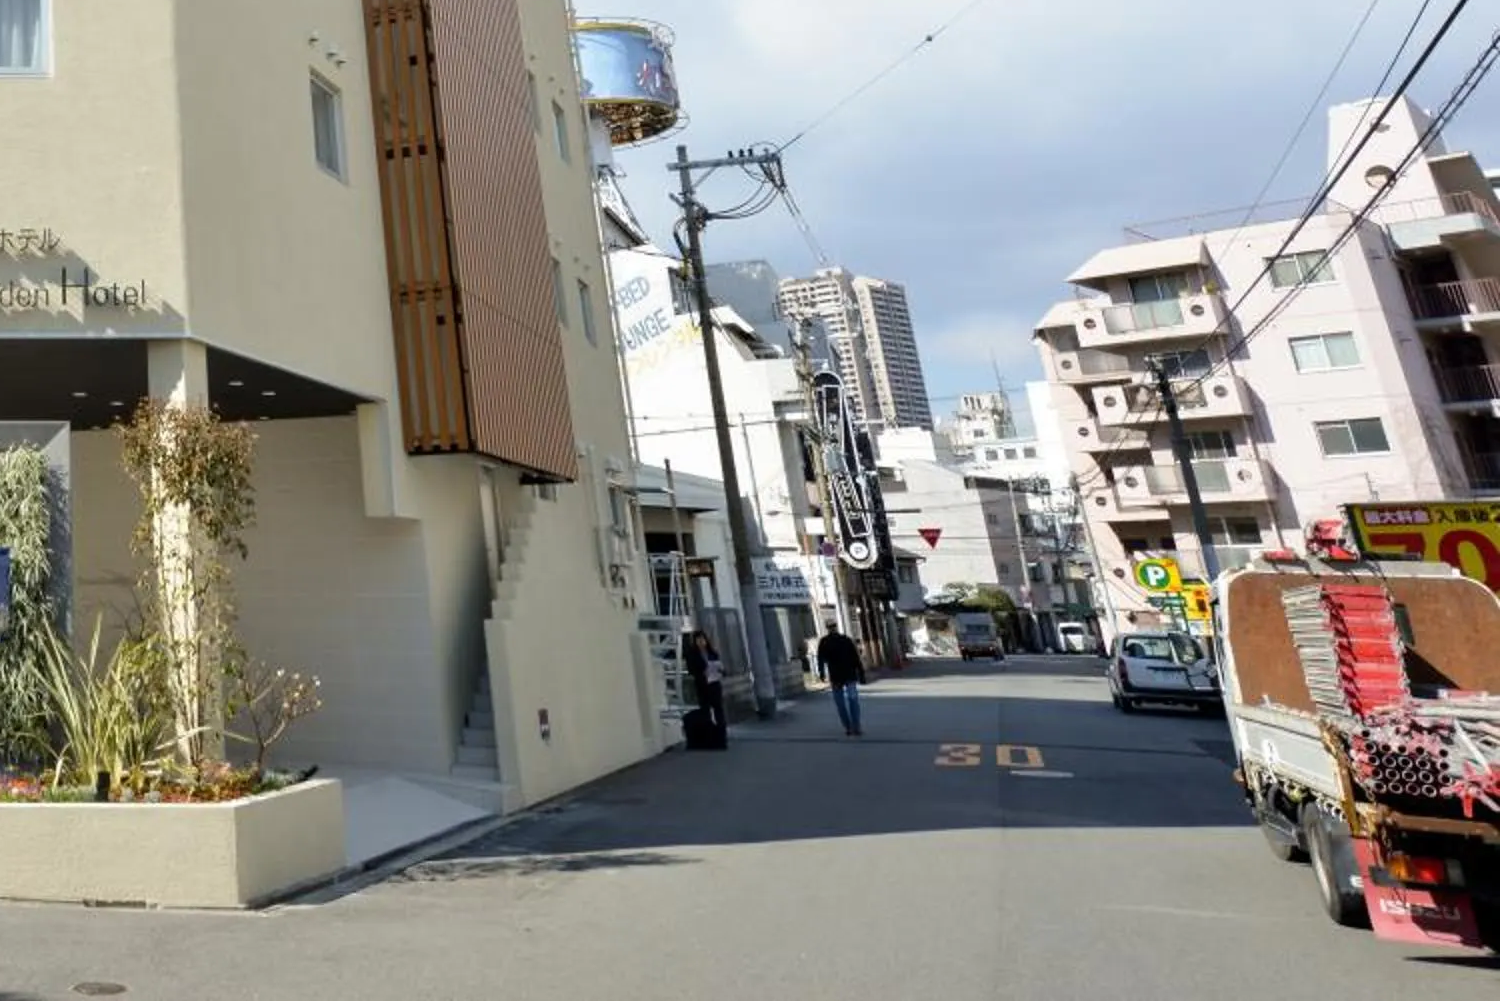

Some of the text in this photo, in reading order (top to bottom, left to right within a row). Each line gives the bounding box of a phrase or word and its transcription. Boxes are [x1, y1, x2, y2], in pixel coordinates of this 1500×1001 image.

[61, 265, 147, 308] Hotel
[621, 307, 671, 351] UNGE
[1145, 566, 1166, 586] P
[934, 743, 1045, 768] 30
